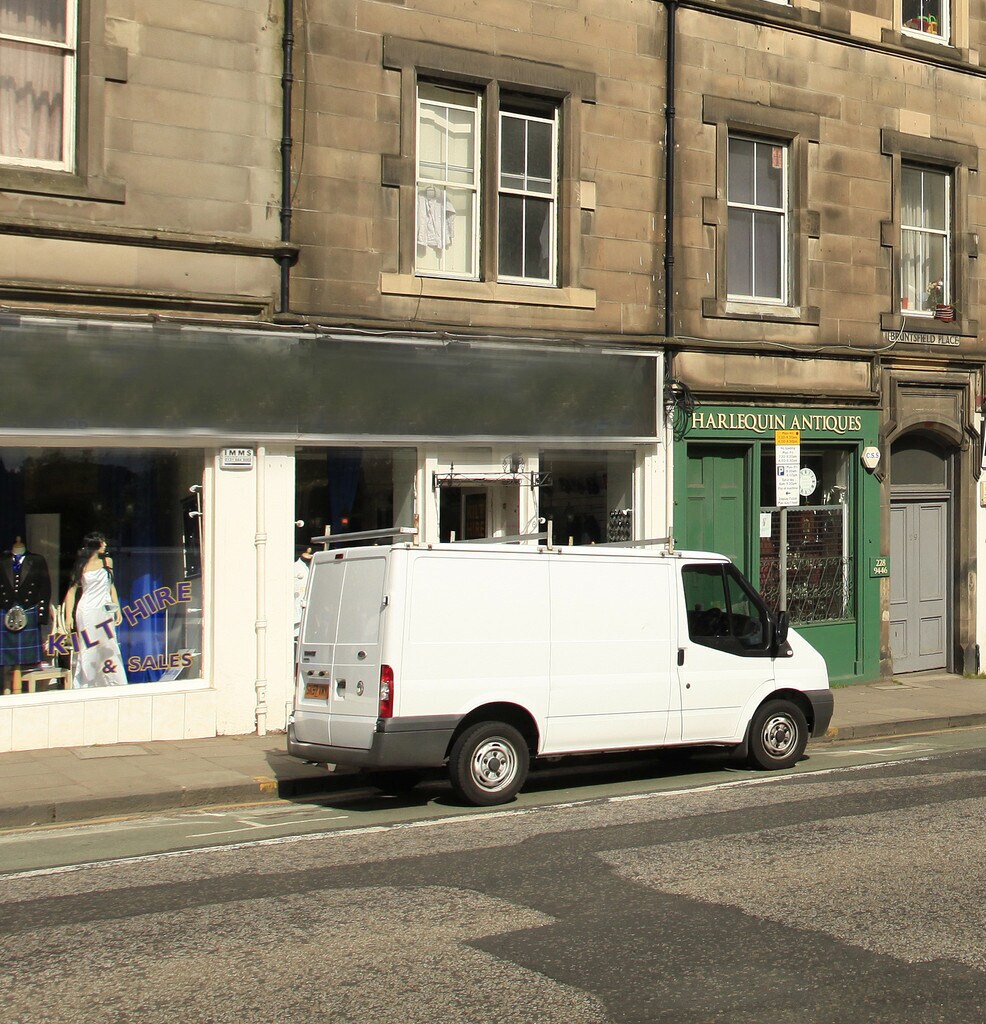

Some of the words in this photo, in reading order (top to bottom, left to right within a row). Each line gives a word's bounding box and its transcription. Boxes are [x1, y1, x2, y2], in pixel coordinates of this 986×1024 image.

[938, 335, 960, 345] PLACE
[691, 412, 786, 433] HARLEQUIN
[790, 414, 862, 434] ANTIQUES
[873, 566, 888, 575] 9446
[875, 558, 886, 567] 228
[47, 617, 115, 656] KILT
[122, 581, 192, 626] HIRE
[102, 659, 117, 674] &
[127, 652, 193, 673] SALES
